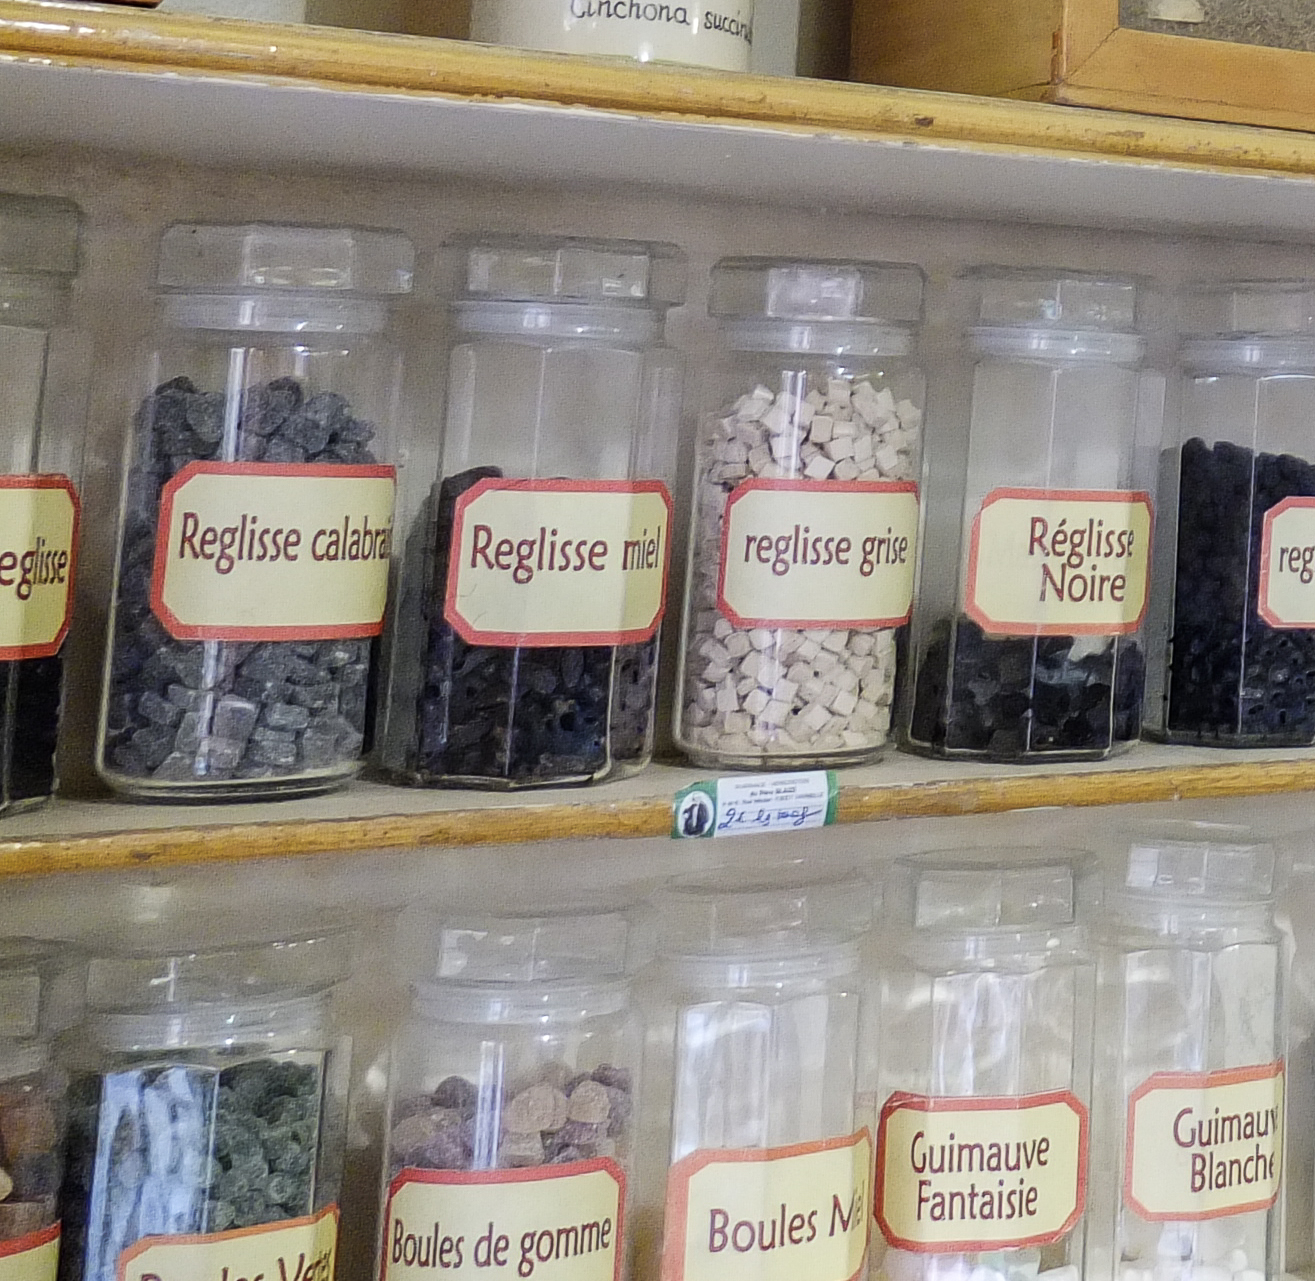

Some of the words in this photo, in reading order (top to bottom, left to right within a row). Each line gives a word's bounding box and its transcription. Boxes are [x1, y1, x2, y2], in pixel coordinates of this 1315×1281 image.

[179, 512, 301, 575] Reglisse
[471, 524, 608, 584] Reglisse
[621, 526, 661, 571] miel
[744, 525, 851, 577] reglisse
[859, 526, 908, 577] grise
[1029, 517, 1134, 566] Réglisse
[0, 537, 68, 600] eglisse
[1040, 562, 1126, 603] Noire
[1172, 1103, 1279, 1149] Guimauv
[910, 1131, 1051, 1175] Guimauve
[915, 1177, 1039, 1223] Fantaisie
[391, 1219, 464, 1271] Boules
[476, 1223, 511, 1268] de
[519, 1216, 613, 1278] gomme
[708, 1203, 818, 1254] Boules
